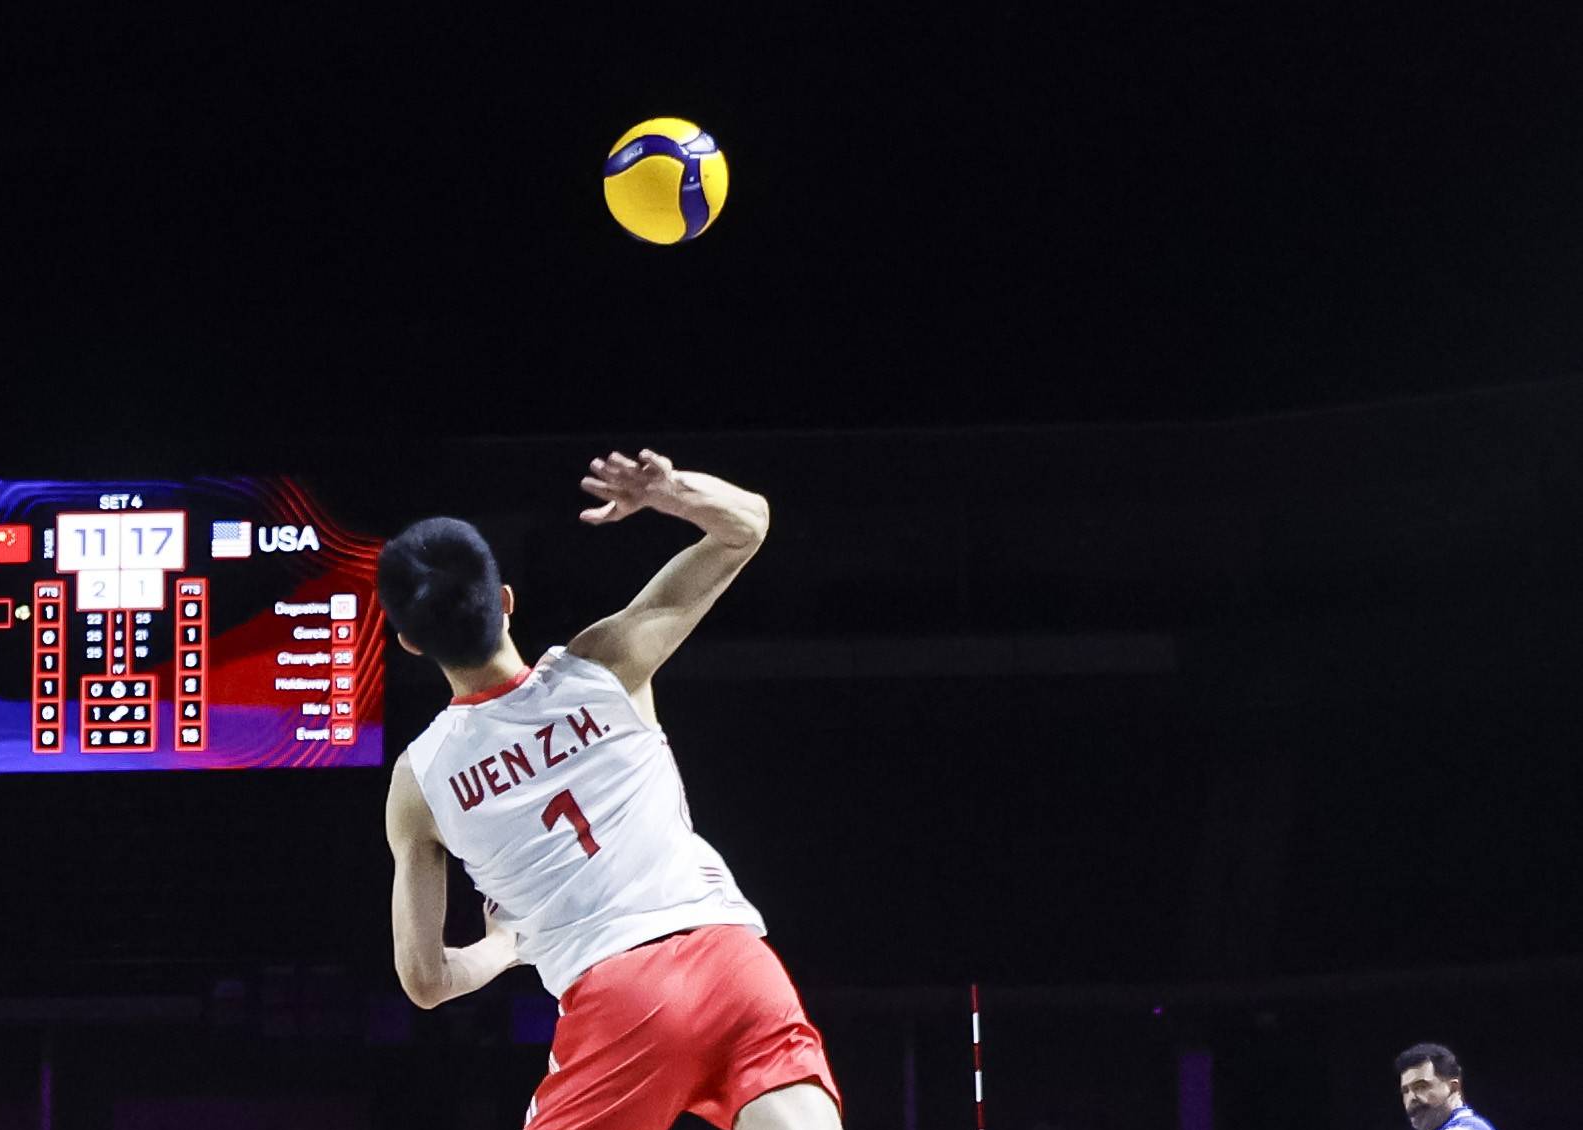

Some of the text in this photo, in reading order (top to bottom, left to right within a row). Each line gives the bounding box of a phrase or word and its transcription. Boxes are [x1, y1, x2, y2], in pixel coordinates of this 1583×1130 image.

[99, 494, 143, 510] SET 4
[74, 528, 106, 556] 11
[131, 528, 173, 556] 17
[258, 525, 320, 552] USA
[38, 587, 59, 598] PTS
[93, 581, 106, 598] 2
[181, 584, 202, 595] PTS
[45, 605, 53, 620] 1
[42, 630, 55, 645] 0
[44, 655, 53, 670] 1
[44, 680, 53, 695] 1
[42, 705, 55, 720] 0
[42, 730, 55, 745] 0
[449, 706, 611, 812] WEN Z.H.
[541, 789, 601, 860] 1
